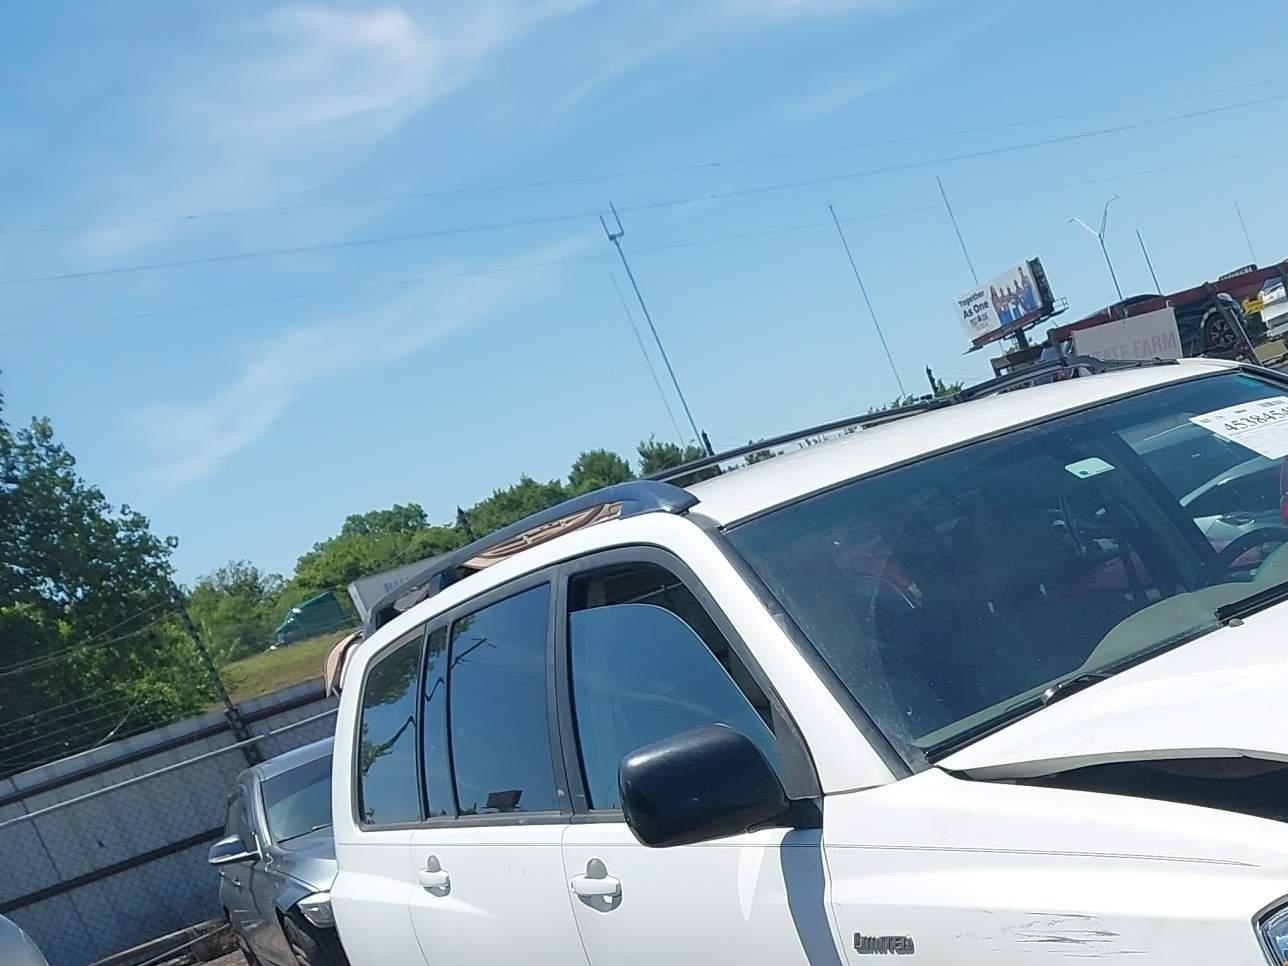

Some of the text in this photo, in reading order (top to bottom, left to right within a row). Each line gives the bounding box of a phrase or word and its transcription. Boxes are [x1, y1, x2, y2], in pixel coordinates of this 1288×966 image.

[958, 290, 985, 308] Together
[963, 308, 974, 320] As
[973, 300, 989, 314] One
[1133, 331, 1177, 358] FARM
